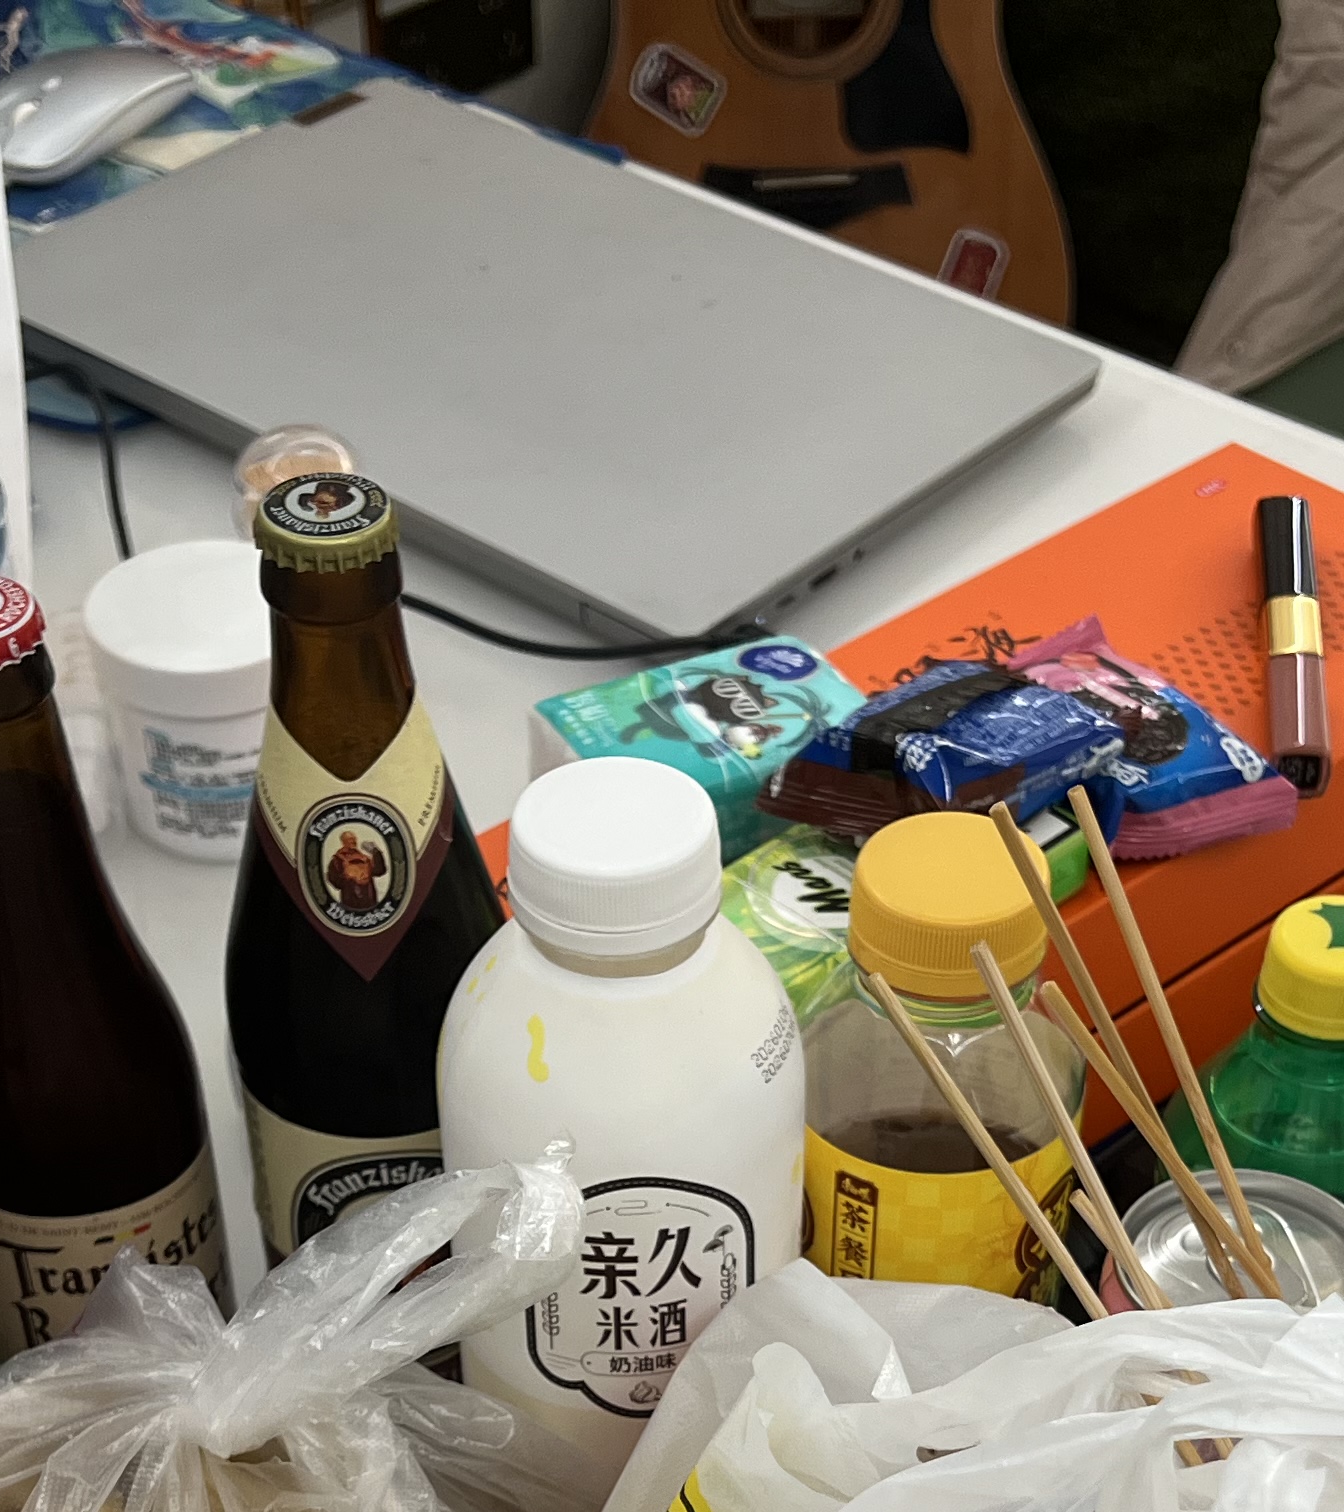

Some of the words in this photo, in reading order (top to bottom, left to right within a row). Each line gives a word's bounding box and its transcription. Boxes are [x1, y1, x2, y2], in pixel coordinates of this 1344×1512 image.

[580, 1225, 703, 1300] 亲久
[596, 1298, 688, 1351] 米酒
[608, 1352, 677, 1374] 奶油味
